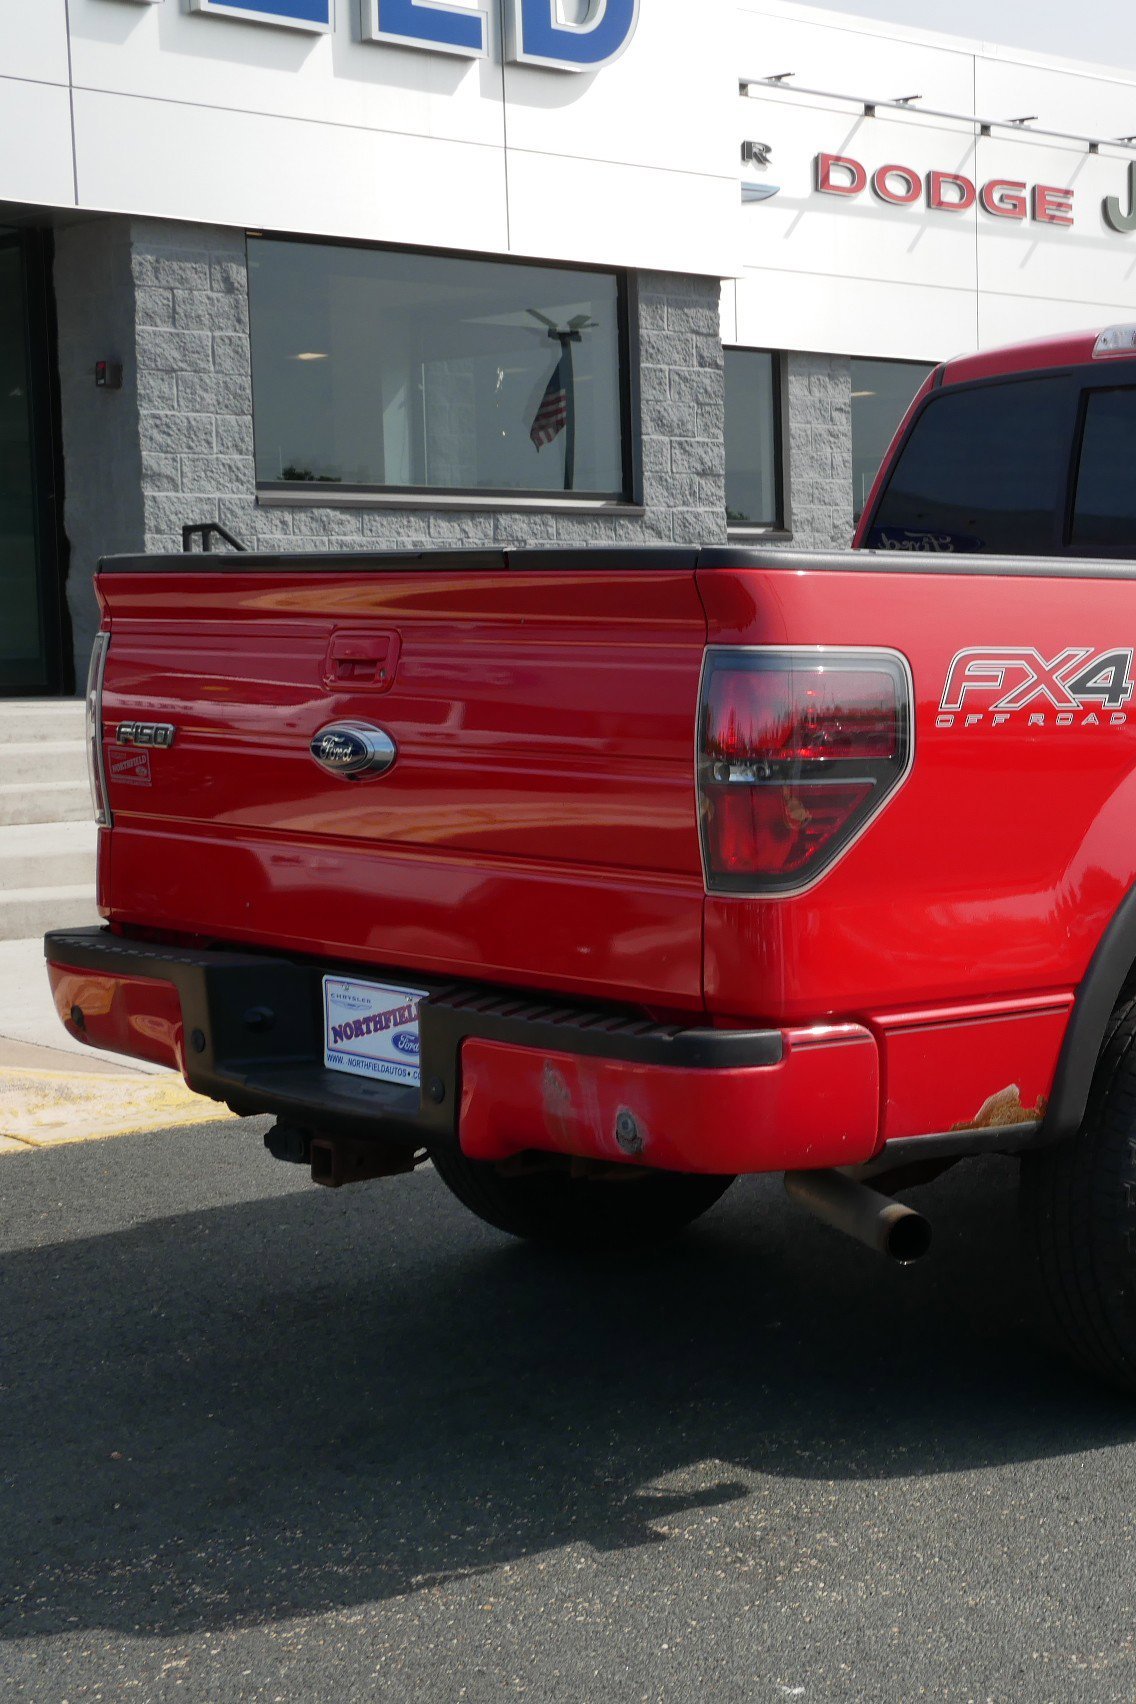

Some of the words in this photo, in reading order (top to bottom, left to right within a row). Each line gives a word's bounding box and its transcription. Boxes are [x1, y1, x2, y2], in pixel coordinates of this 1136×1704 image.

[815, 152, 1075, 226] DODGE
[938, 645, 1135, 711] FX4
[935, 713, 1011, 728] OFF
[1027, 712, 1128, 727] ROAD
[319, 734, 353, 762] Ford
